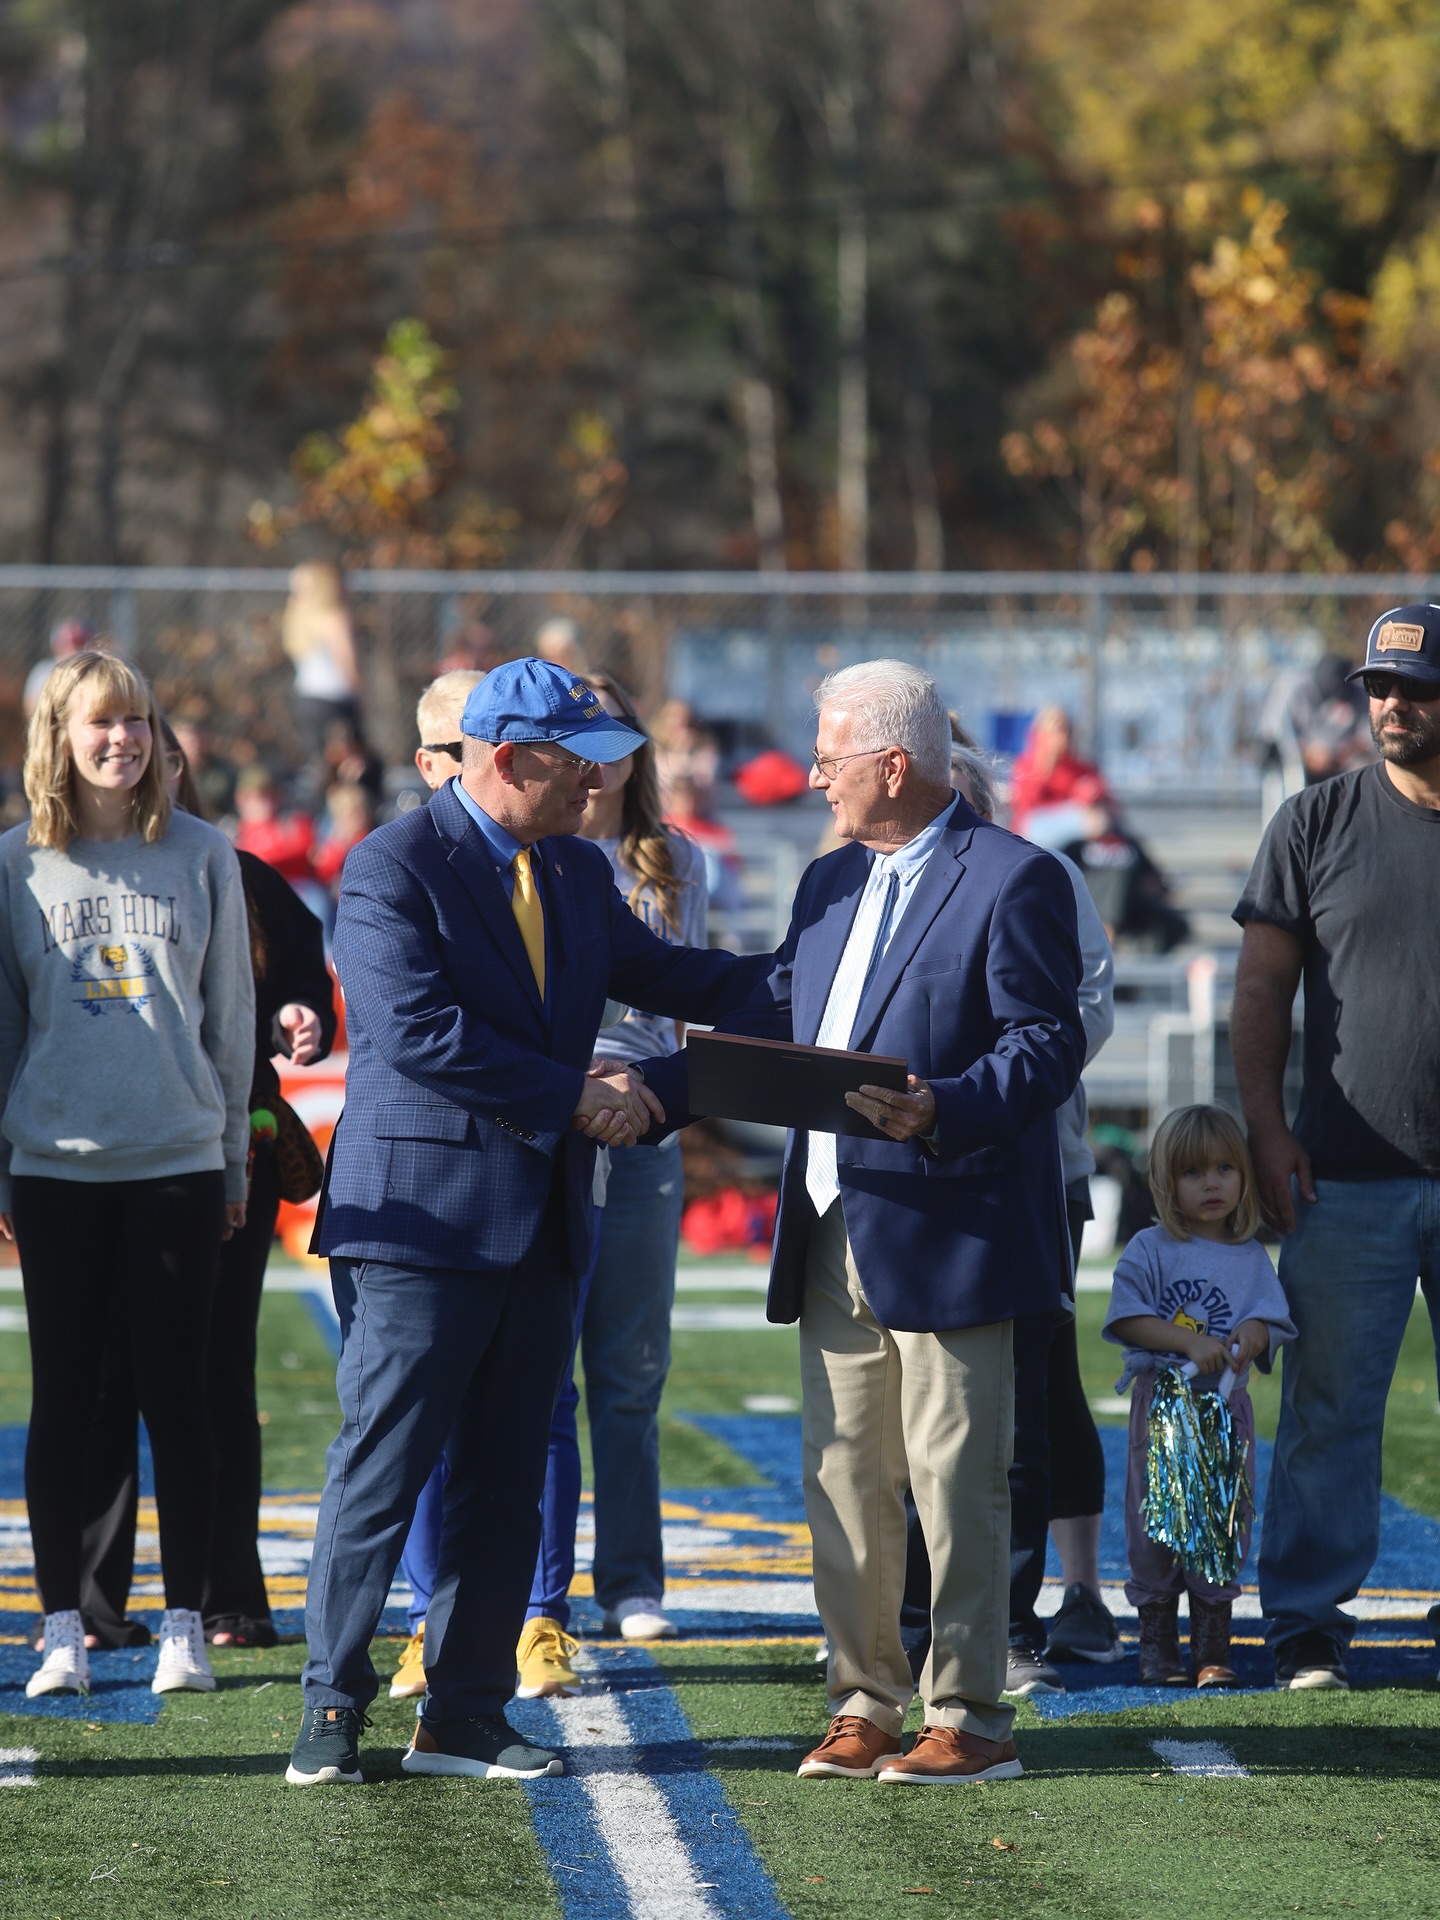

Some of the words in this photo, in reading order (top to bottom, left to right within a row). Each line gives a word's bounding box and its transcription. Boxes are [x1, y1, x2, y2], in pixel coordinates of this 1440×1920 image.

[39, 896, 111, 954] MARS
[120, 894, 181, 946] HILL
[86, 978, 143, 999] LIONS
